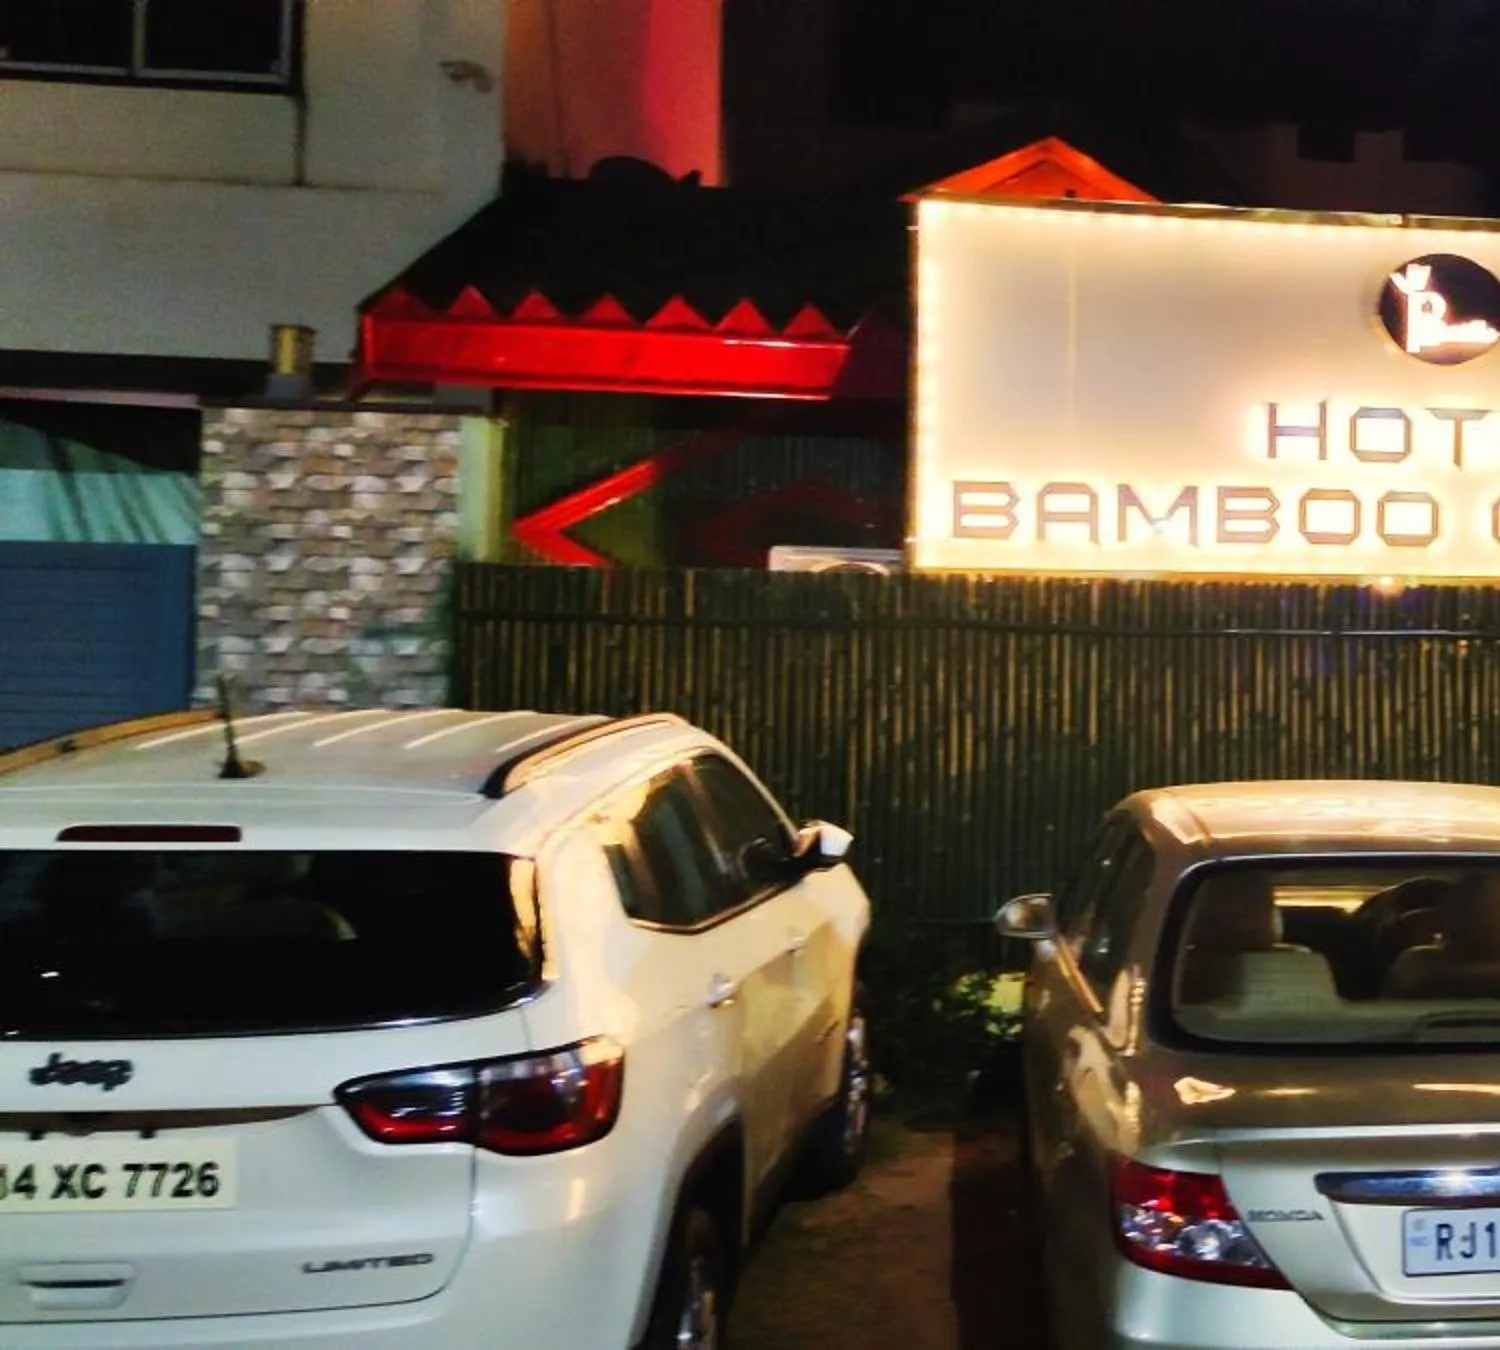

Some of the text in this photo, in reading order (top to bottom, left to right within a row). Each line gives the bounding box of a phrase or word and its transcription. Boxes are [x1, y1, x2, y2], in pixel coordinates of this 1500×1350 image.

[952, 479, 1440, 548] BAMBOO
[50, 1162, 108, 1200] XC
[122, 1160, 221, 1199] 7726
[301, 1252, 435, 1274] LIMITED
